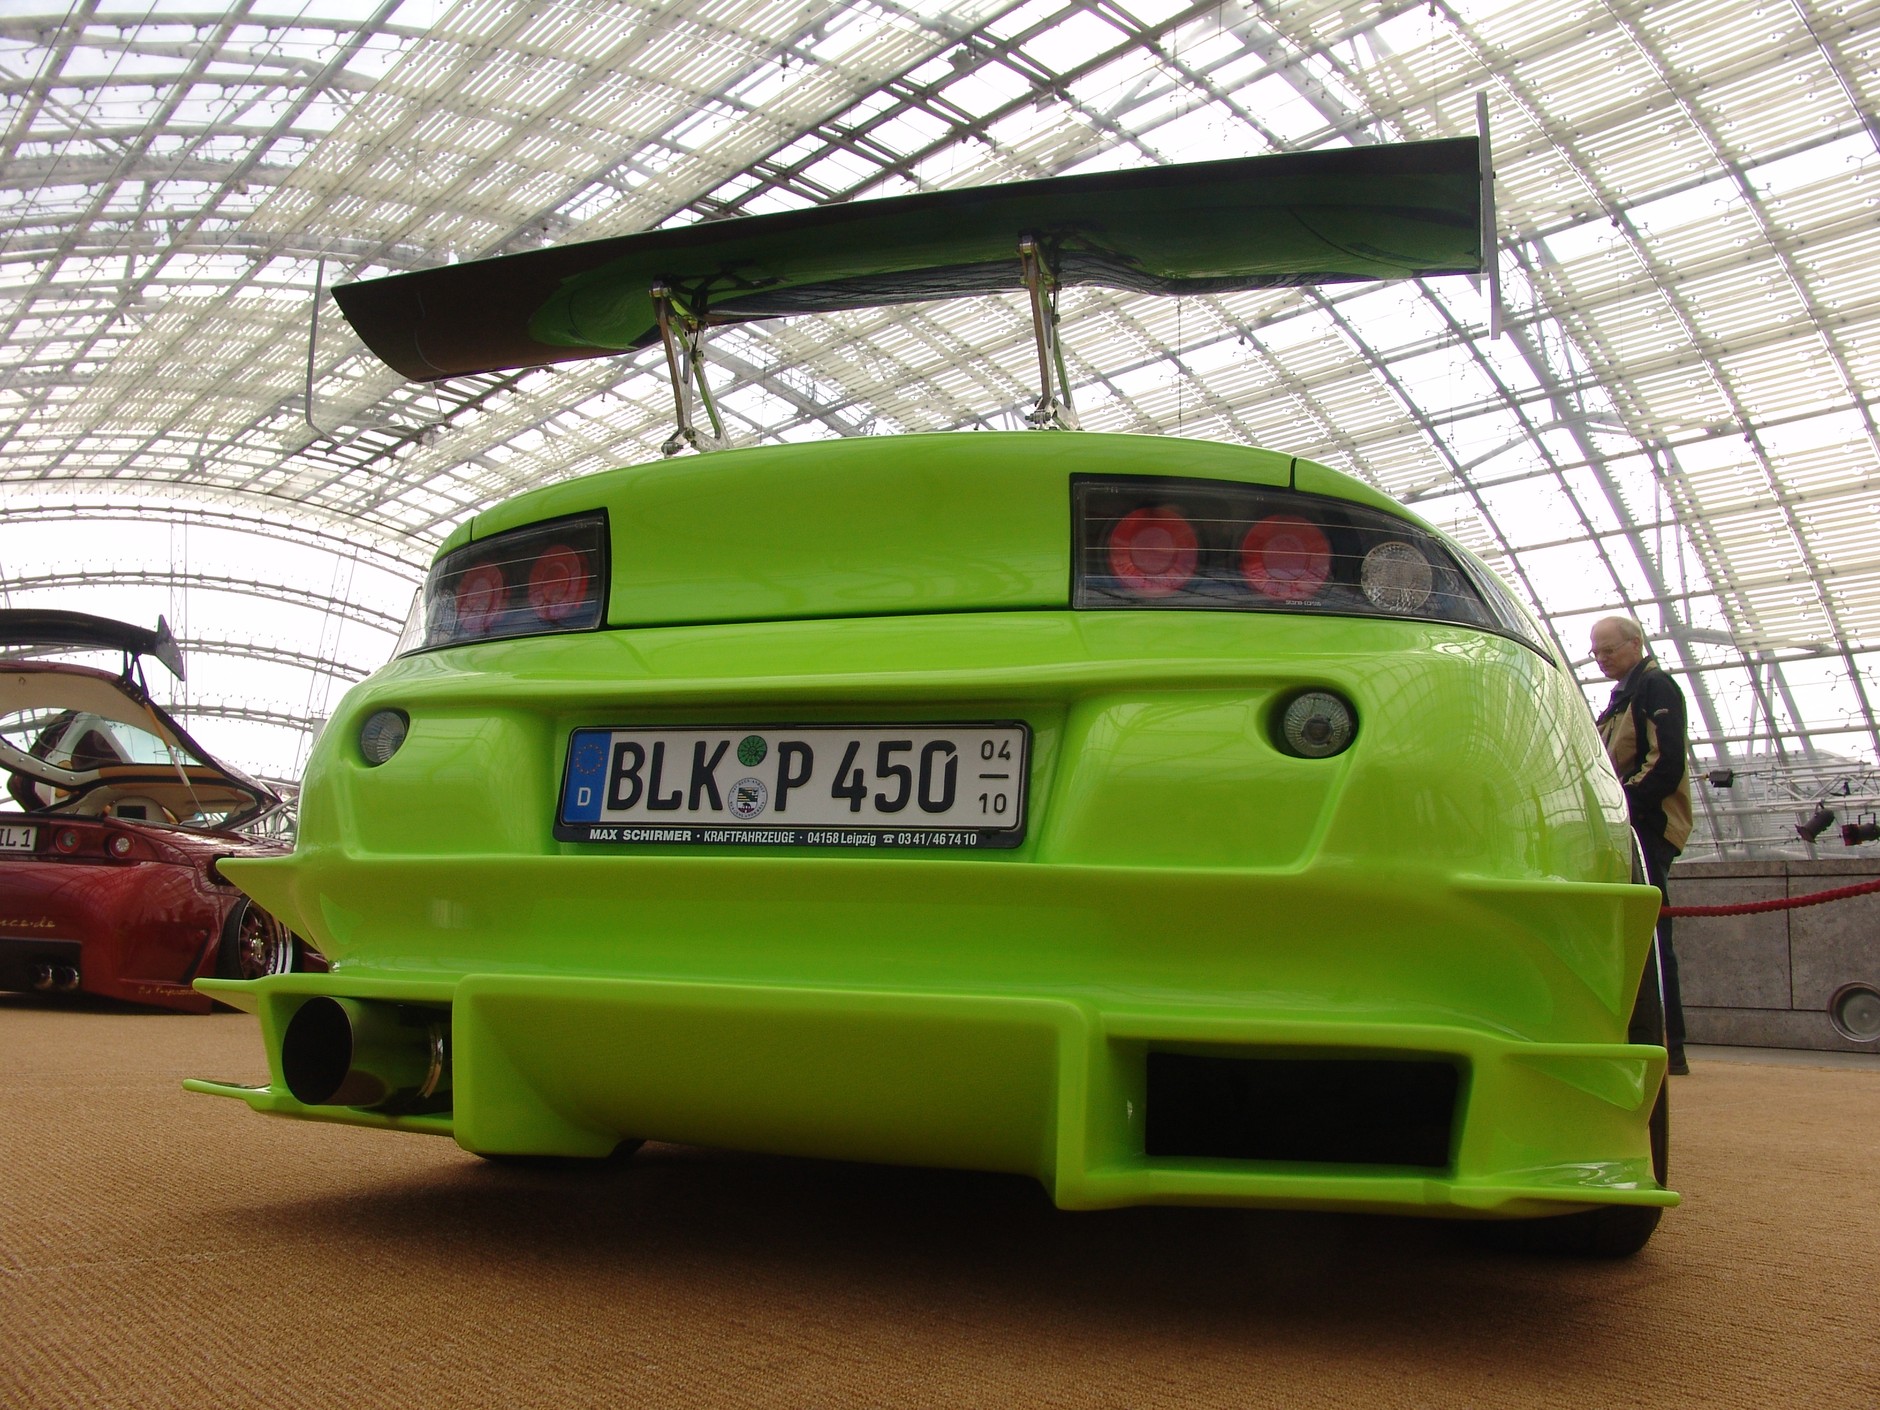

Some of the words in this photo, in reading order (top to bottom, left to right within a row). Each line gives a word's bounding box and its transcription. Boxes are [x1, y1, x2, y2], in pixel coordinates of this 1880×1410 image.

[980, 739, 1011, 761] 04
[606, 740, 731, 811] BLK
[774, 740, 815, 812] P
[831, 740, 959, 814] 450
[576, 786, 592, 807] D
[978, 792, 1007, 814] 10
[20, 829, 31, 848] 1
[589, 828, 618, 840] MAX
[622, 829, 692, 842] SCHIRMER
[703, 830, 796, 843] KRAFTFAHRZEUGE
[807, 832, 839, 844] 04158
[840, 832, 877, 847] Leipzig
